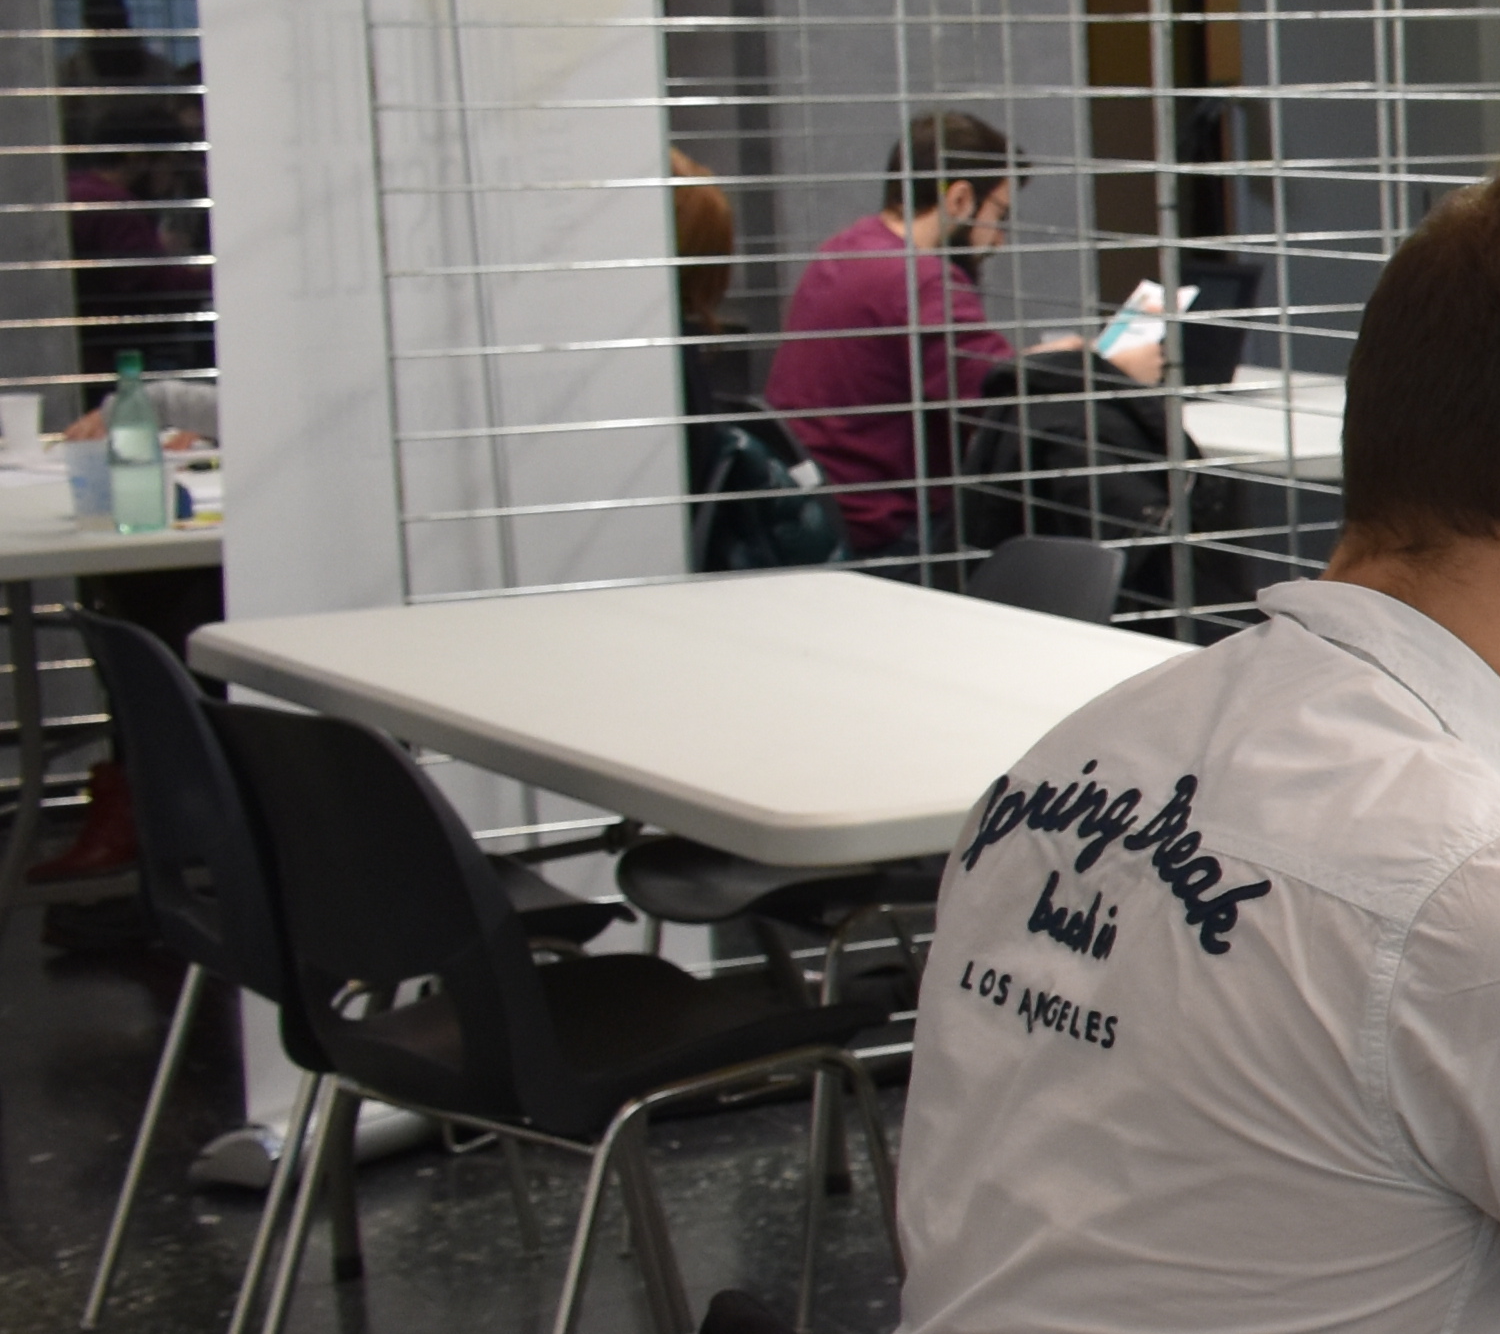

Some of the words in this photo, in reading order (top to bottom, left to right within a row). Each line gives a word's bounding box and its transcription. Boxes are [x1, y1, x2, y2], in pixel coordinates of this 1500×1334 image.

[960, 758, 1143, 875] pring
[960, 959, 1013, 1006] LOS
[1017, 987, 1119, 1049] ANGELES
